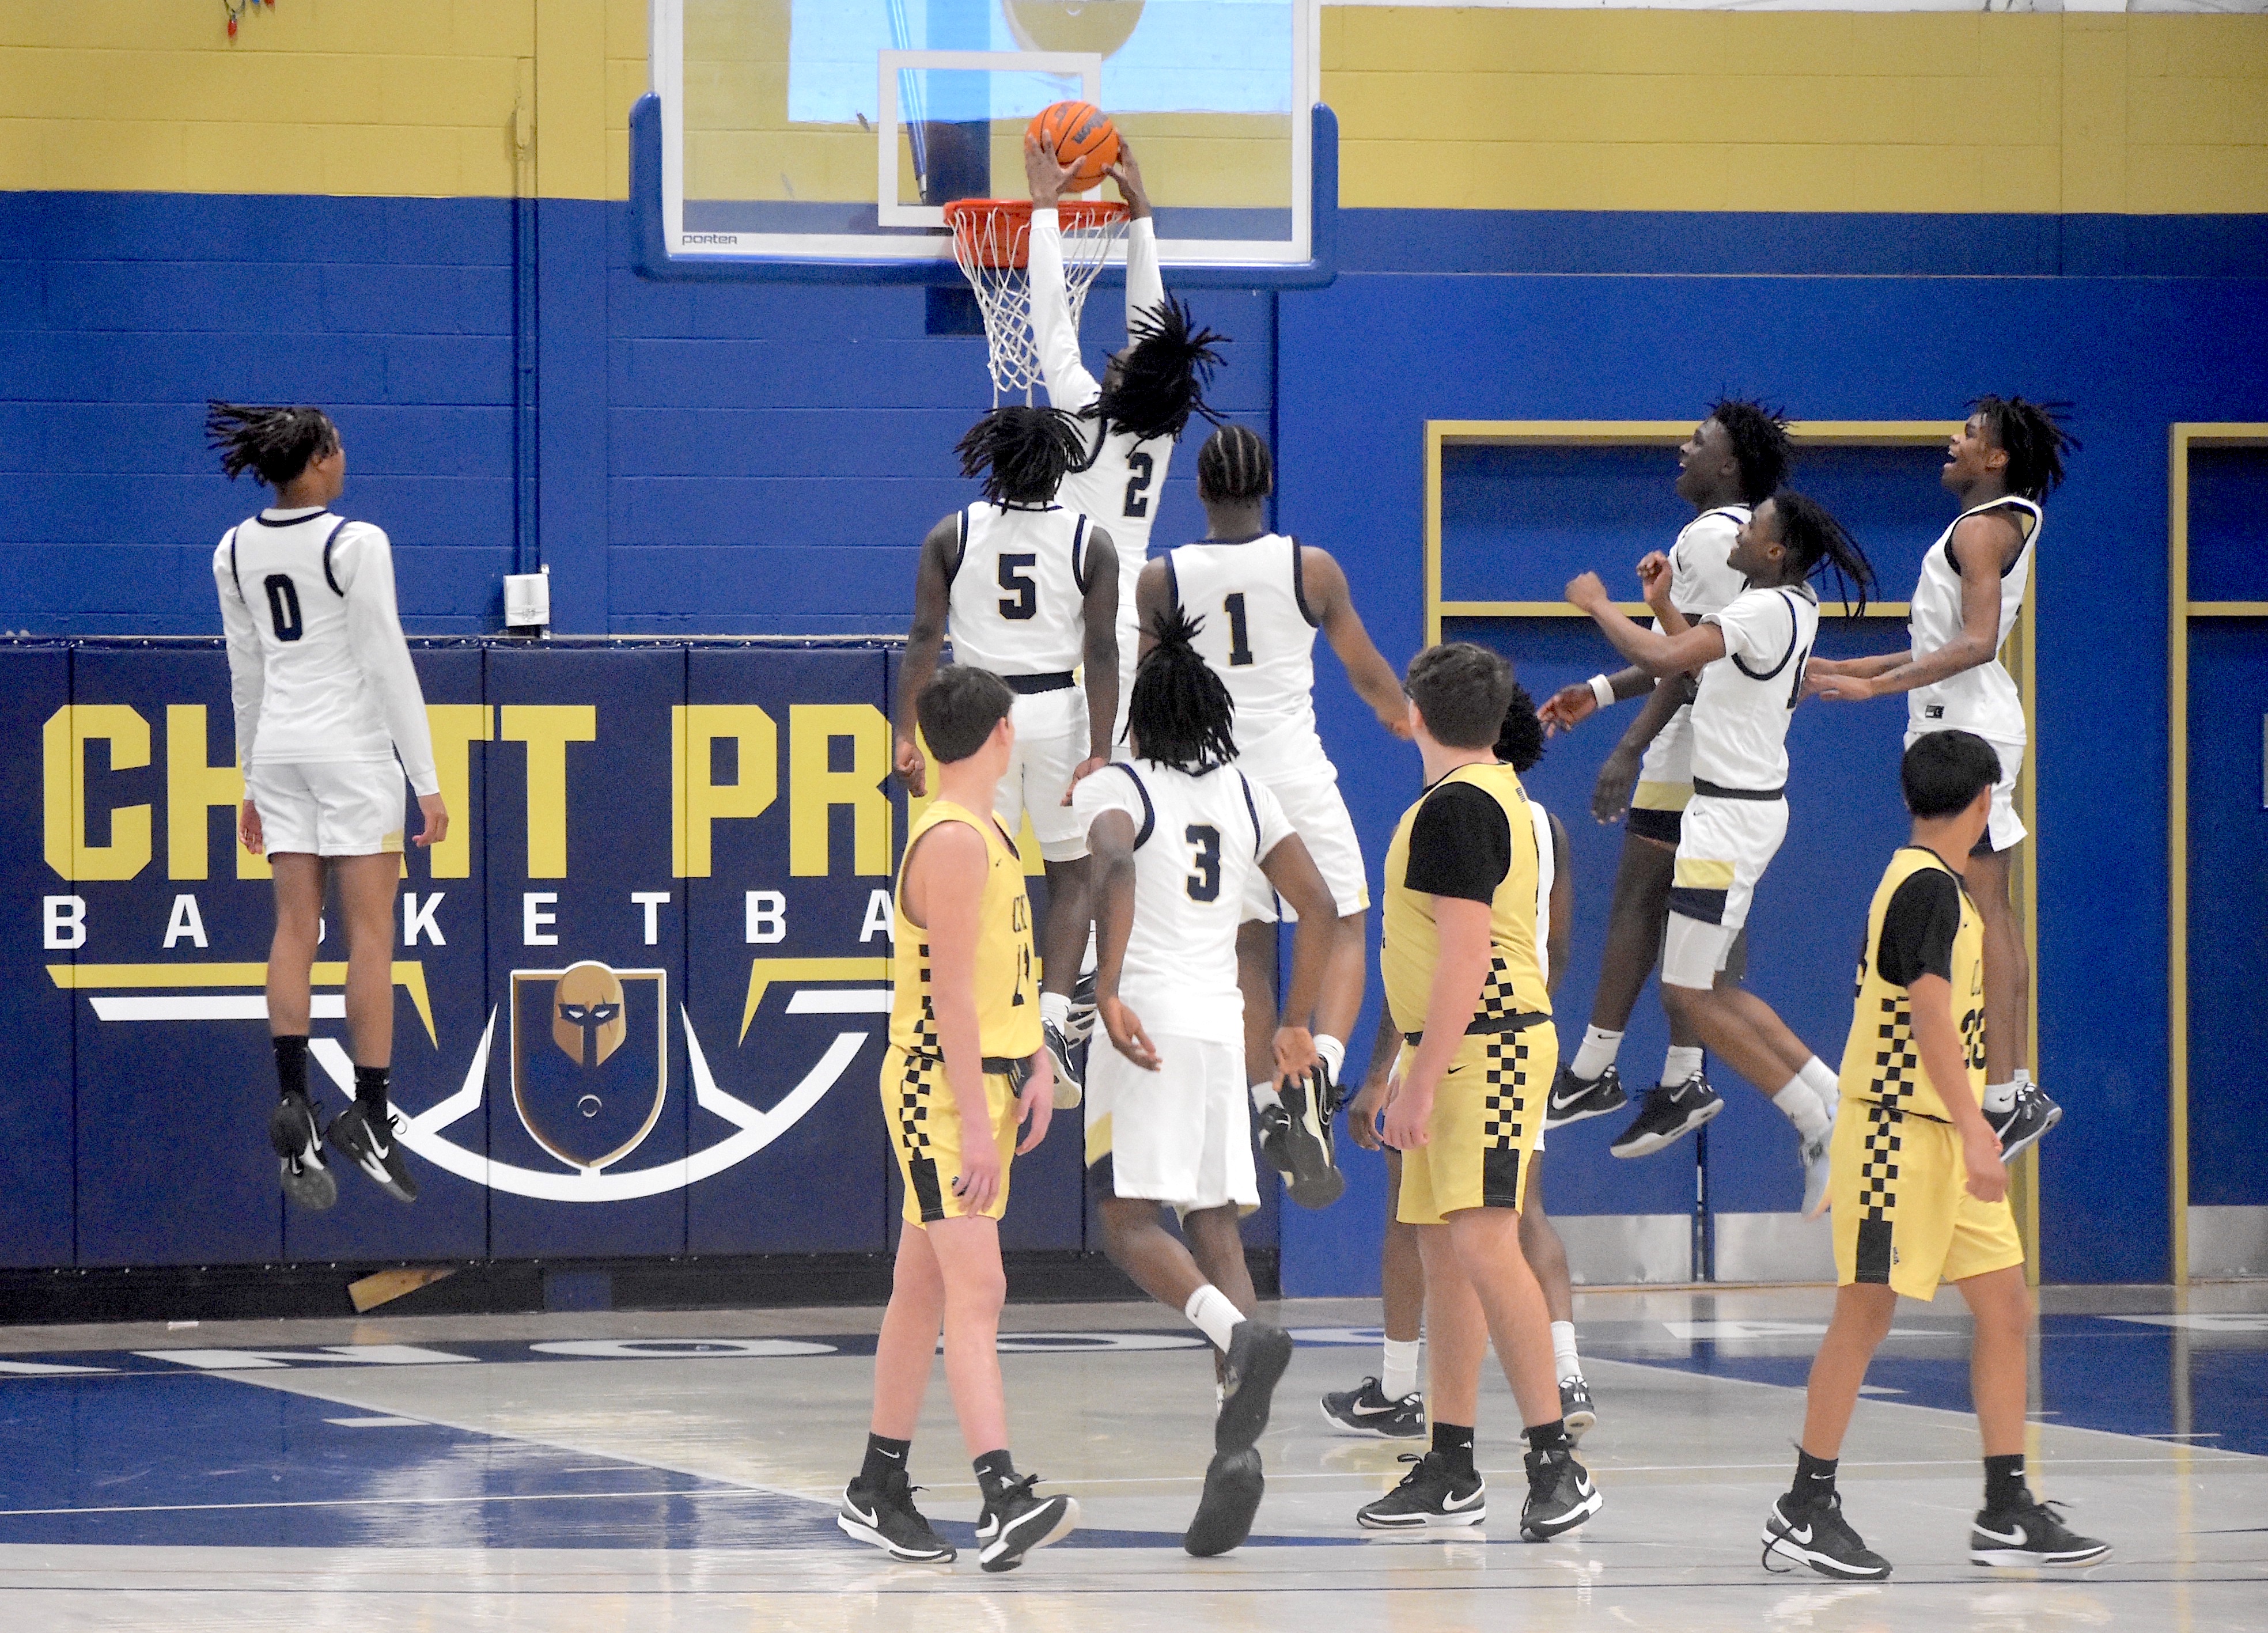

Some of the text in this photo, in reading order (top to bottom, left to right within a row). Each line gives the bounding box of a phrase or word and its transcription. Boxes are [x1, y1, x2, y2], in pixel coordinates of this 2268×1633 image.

[1123, 452, 1153, 517] 2
[263, 574, 303, 642] 0
[998, 552, 1036, 620] 5
[1224, 592, 1254, 666] 1
[43, 703, 596, 882] CHTT
[1184, 823, 1221, 903] 3
